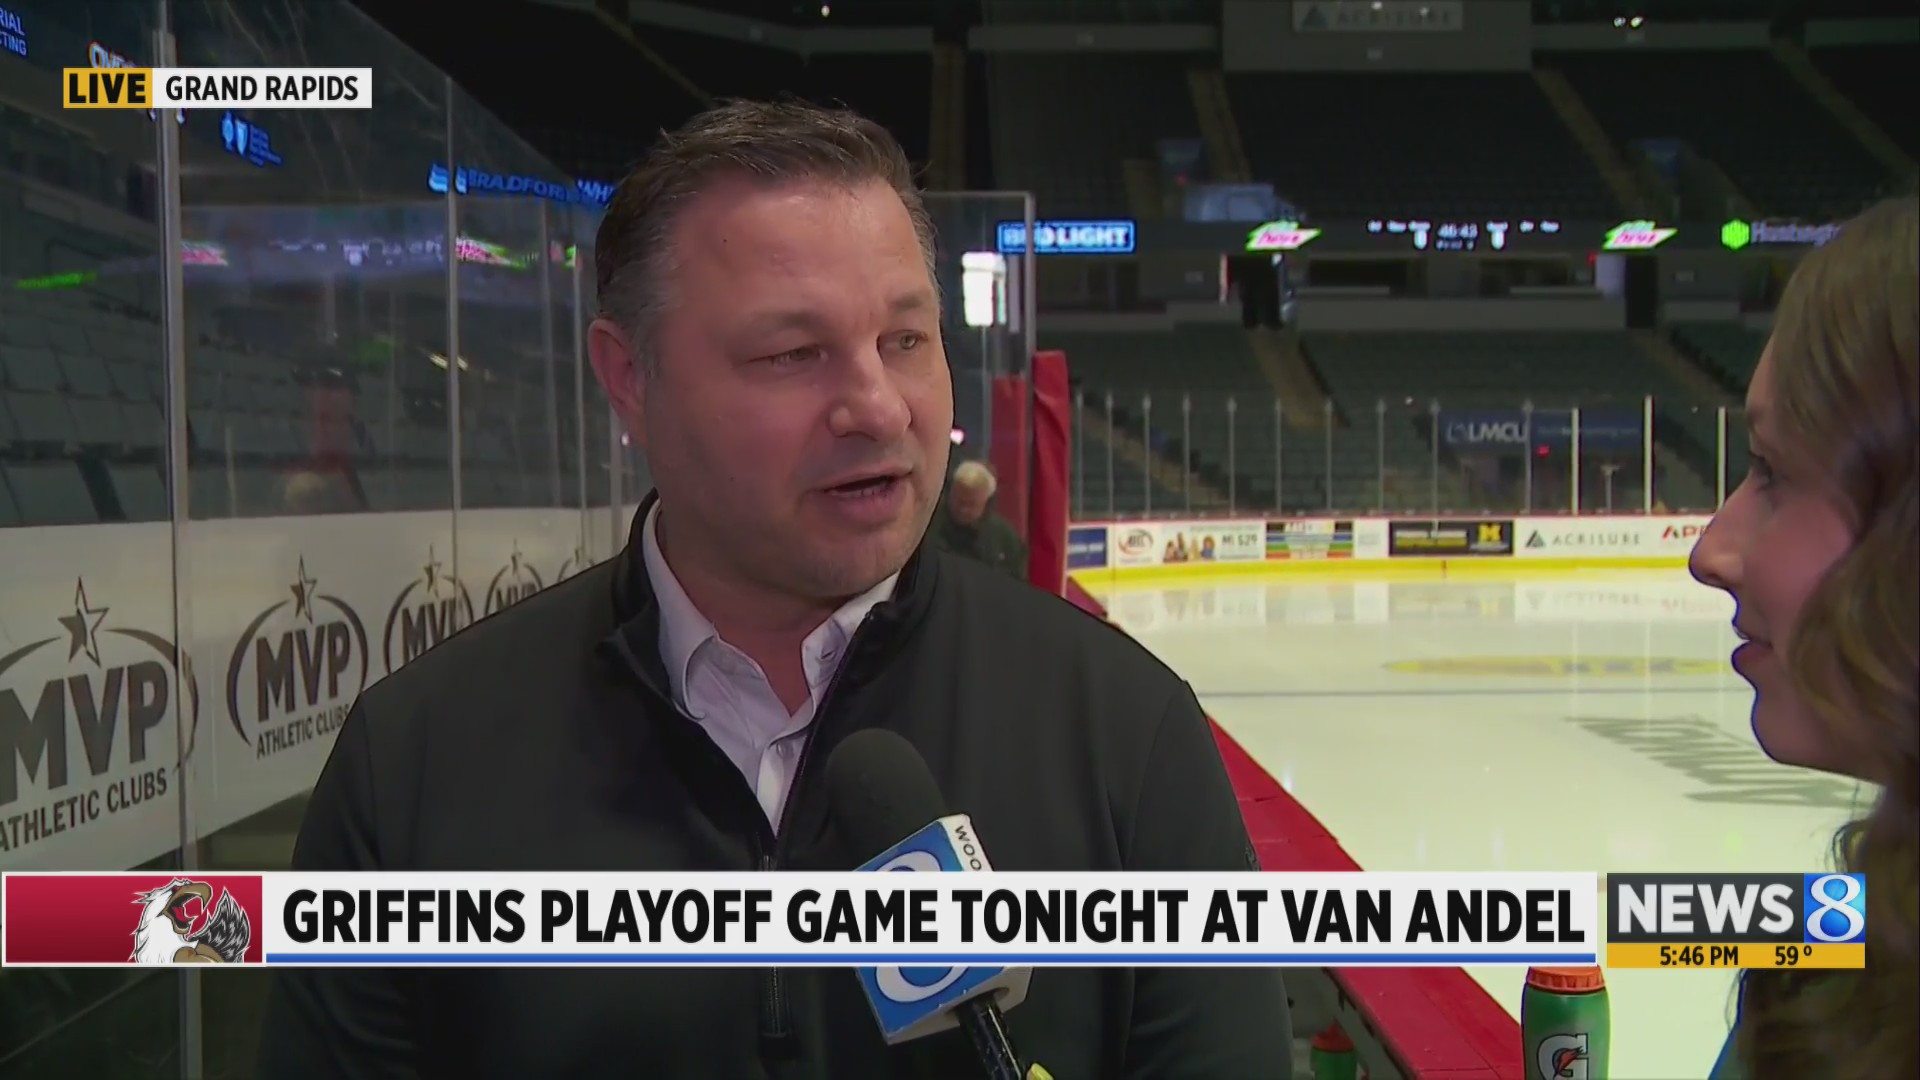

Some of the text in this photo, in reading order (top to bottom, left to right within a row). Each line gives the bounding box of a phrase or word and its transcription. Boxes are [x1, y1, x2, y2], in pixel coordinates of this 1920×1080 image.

[1057, 227, 1129, 246] LIGHT
[1468, 422, 1528, 442] LMCU
[1478, 524, 1502, 543] M
[1552, 532, 1640, 546] ACRISURE
[256, 621, 350, 723] MVP
[0, 661, 168, 806] MVP
[256, 717, 313, 760] ATHLETIC
[107, 767, 167, 813] CLUBS
[1537, 1033, 1589, 1080] G
